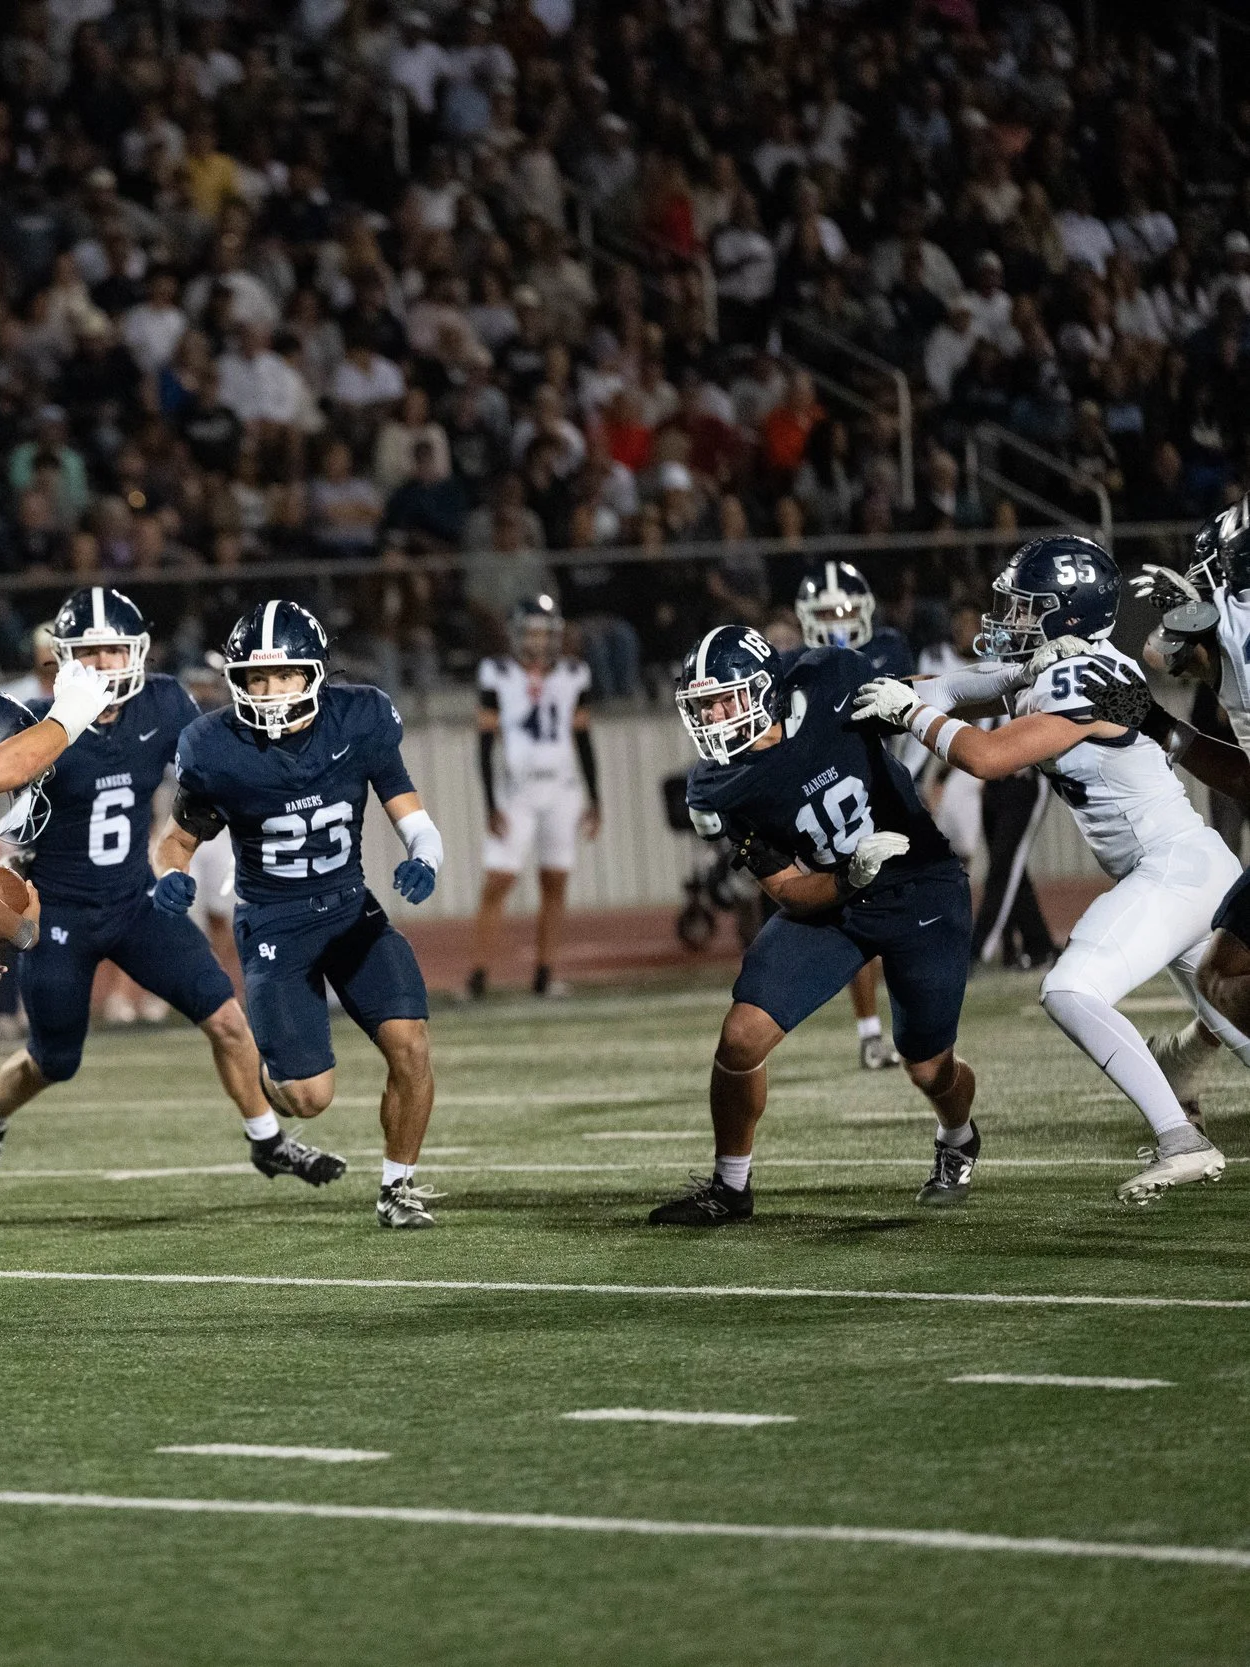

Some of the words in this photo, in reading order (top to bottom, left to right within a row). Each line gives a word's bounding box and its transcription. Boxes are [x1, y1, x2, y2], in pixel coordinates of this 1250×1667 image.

[1053, 554, 1096, 585] 55
[252, 652, 283, 660] Riddell
[738, 633, 771, 663] 18
[95, 772, 132, 790] RANGERS
[801, 766, 840, 797] RANGERS
[285, 794, 324, 813] RANGERS
[88, 786, 135, 866] 6
[795, 775, 875, 865] 18
[261, 800, 353, 878] 23
[258, 943, 277, 960] SV
